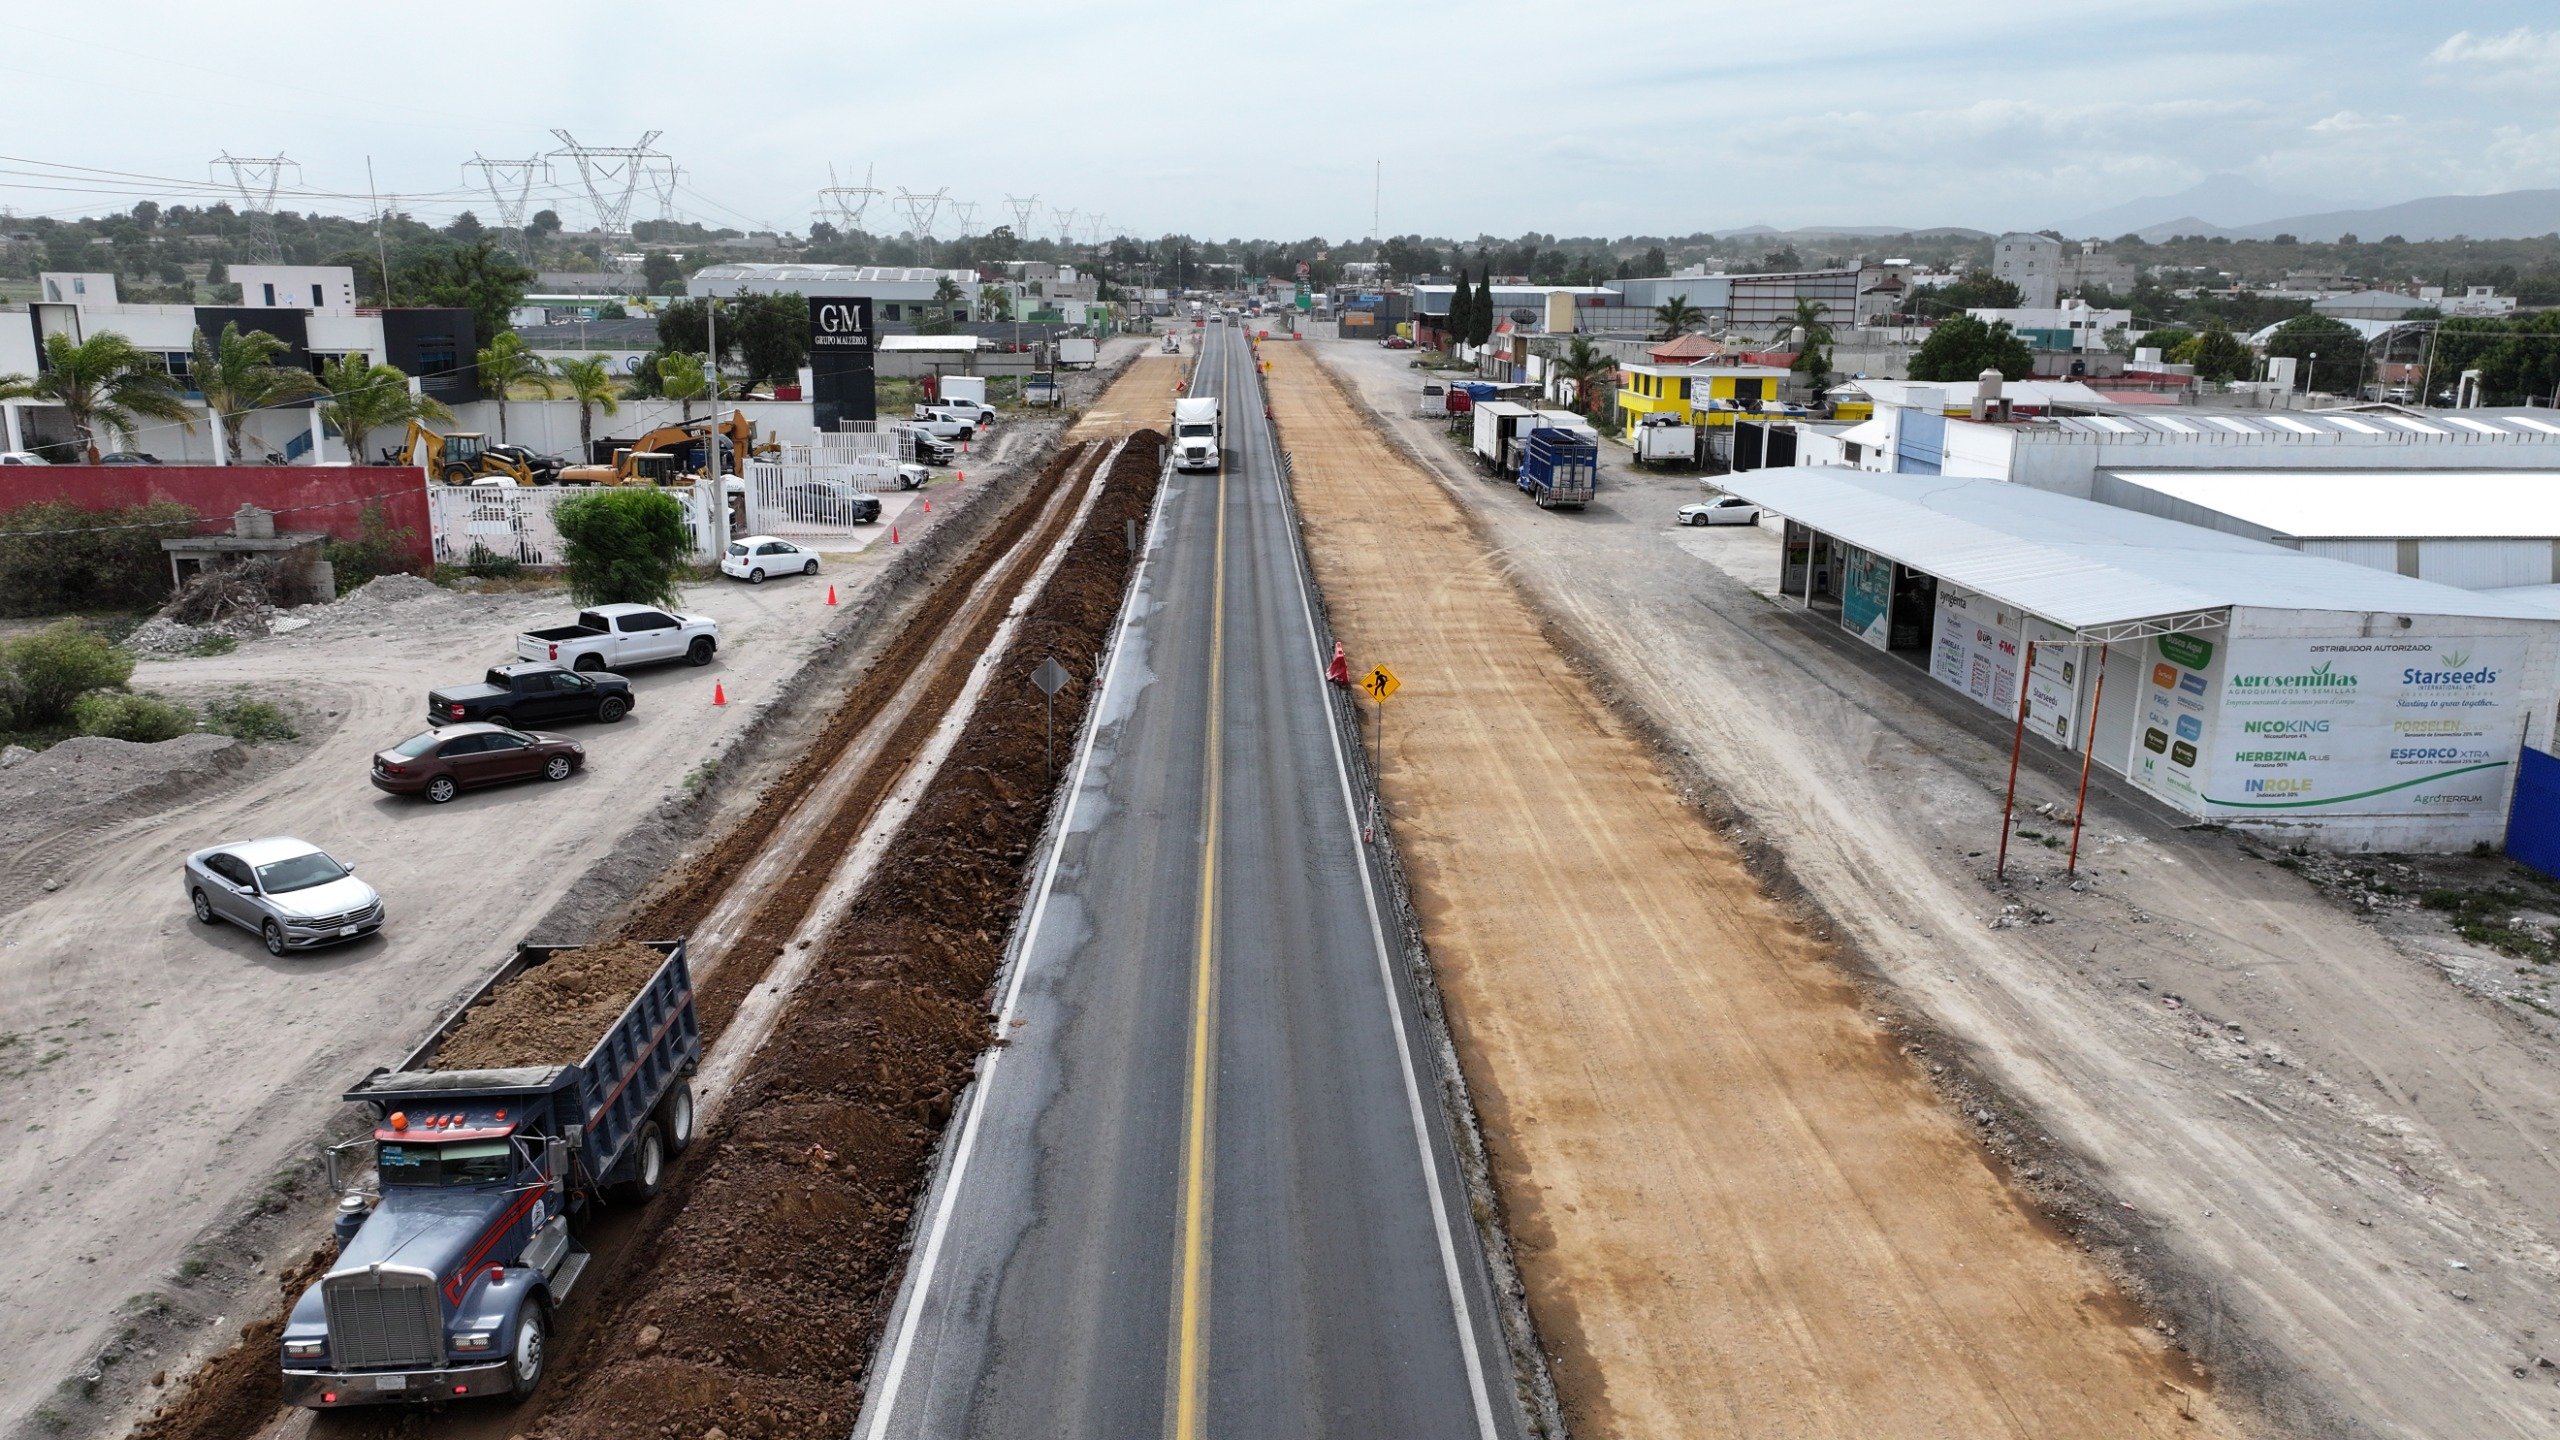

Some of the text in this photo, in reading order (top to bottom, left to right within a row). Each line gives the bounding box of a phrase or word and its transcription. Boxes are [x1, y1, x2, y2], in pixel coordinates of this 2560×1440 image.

[820, 304, 862, 333] GM
[814, 335, 868, 345] GRUPO MAIZEROS
[1940, 589, 1967, 609] syngenta
[1982, 632, 1993, 645] UPL
[1999, 640, 2016, 656] FMC
[2310, 644, 2433, 653] DISTRIBUIDOR AUTORIZADO:
[2228, 672, 2358, 688] Agrosemillas
[2402, 667, 2496, 684] Starseeds
[2226, 699, 2251, 708] Empresa
[2396, 699, 2429, 709] Starting
[2430, 699, 2438, 707] to
[2440, 700, 2460, 709] grow
[2244, 720, 2330, 733] NICOKING
[2394, 720, 2460, 732] PORSELEN
[2235, 751, 2307, 762] HERBZINA
[2390, 748, 2490, 759] ESFORCO XTRA
[2245, 779, 2313, 792] INROLE
